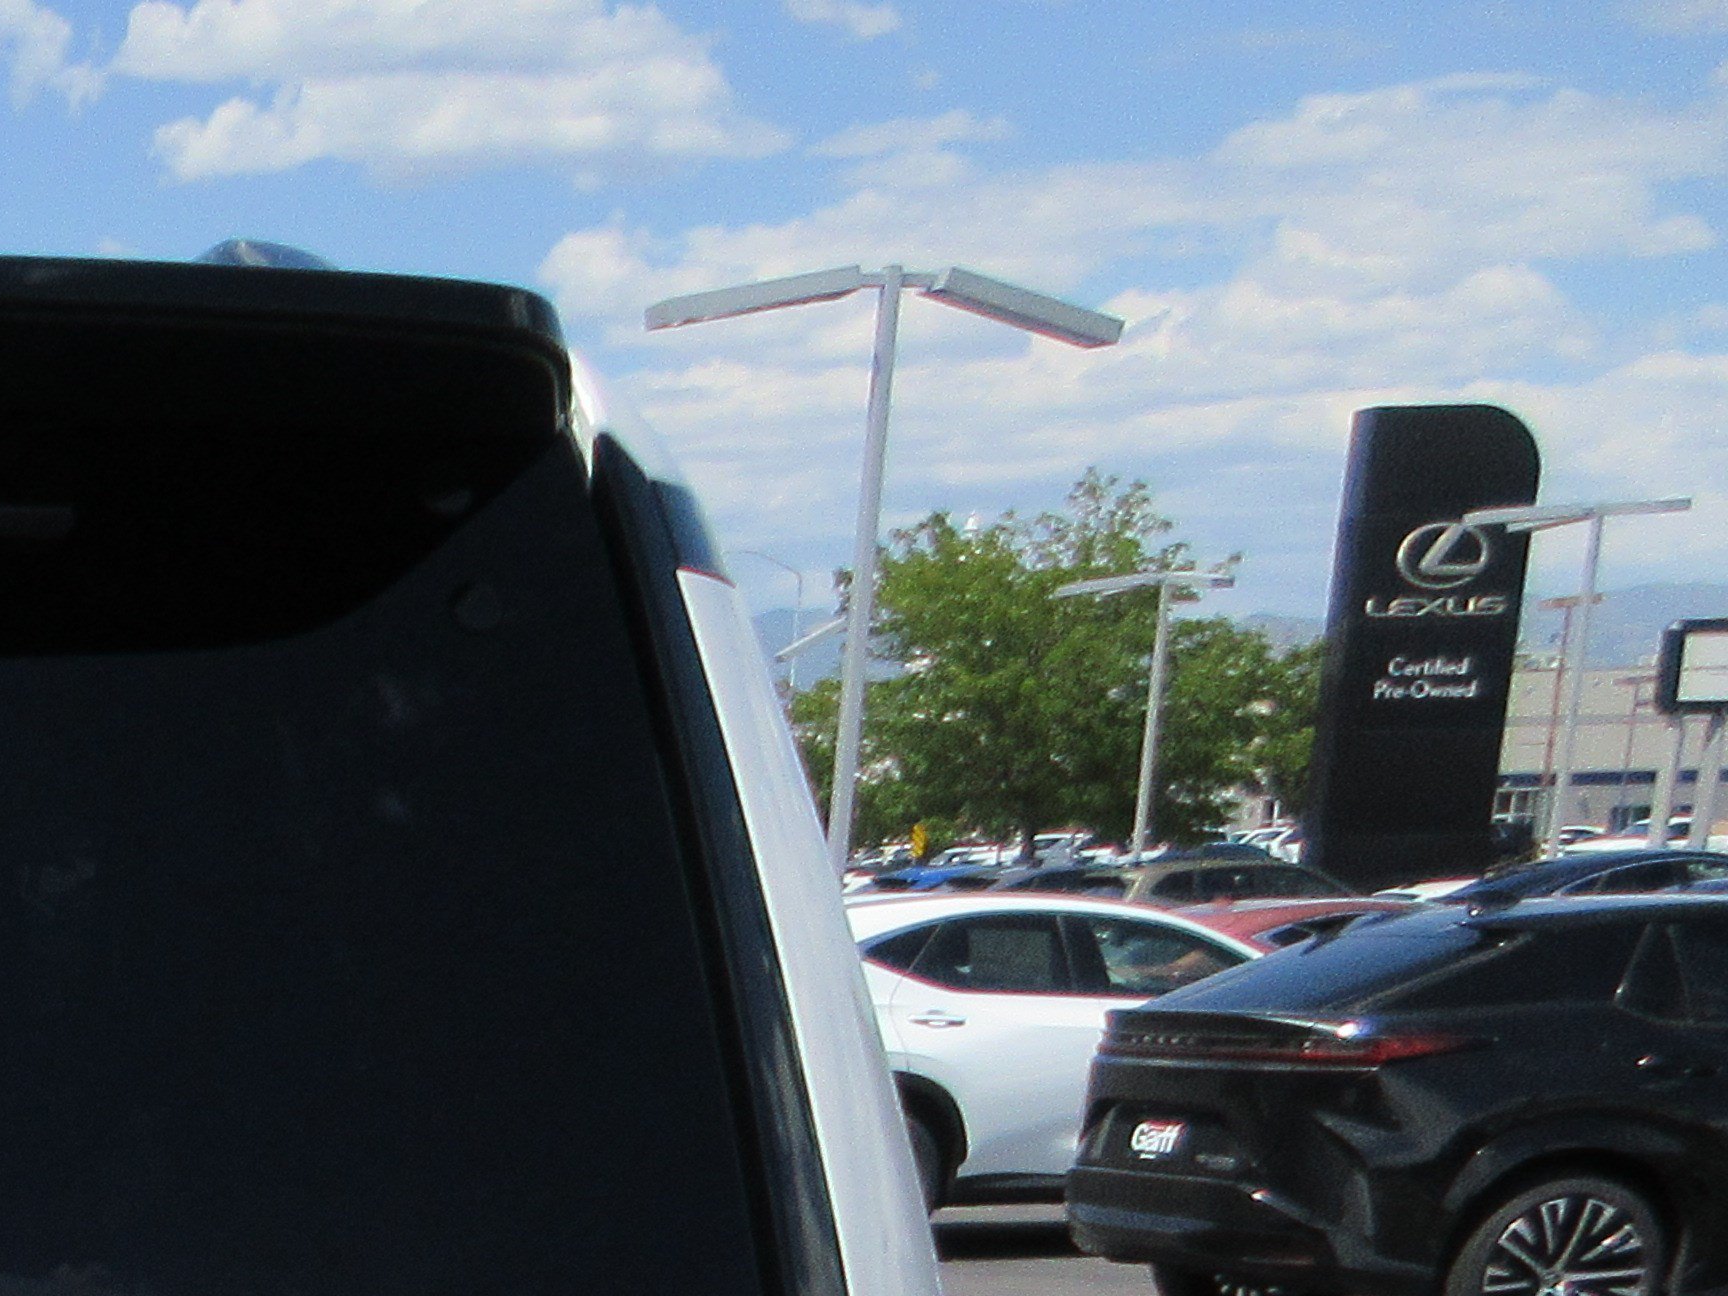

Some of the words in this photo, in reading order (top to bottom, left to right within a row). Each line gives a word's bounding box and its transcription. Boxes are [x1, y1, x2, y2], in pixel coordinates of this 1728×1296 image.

[1365, 596, 1509, 617] LEXUS
[1388, 657, 1472, 676] Certified
[1373, 679, 1478, 699] Pre-Owned
[1131, 1122, 1184, 1153] Garff
